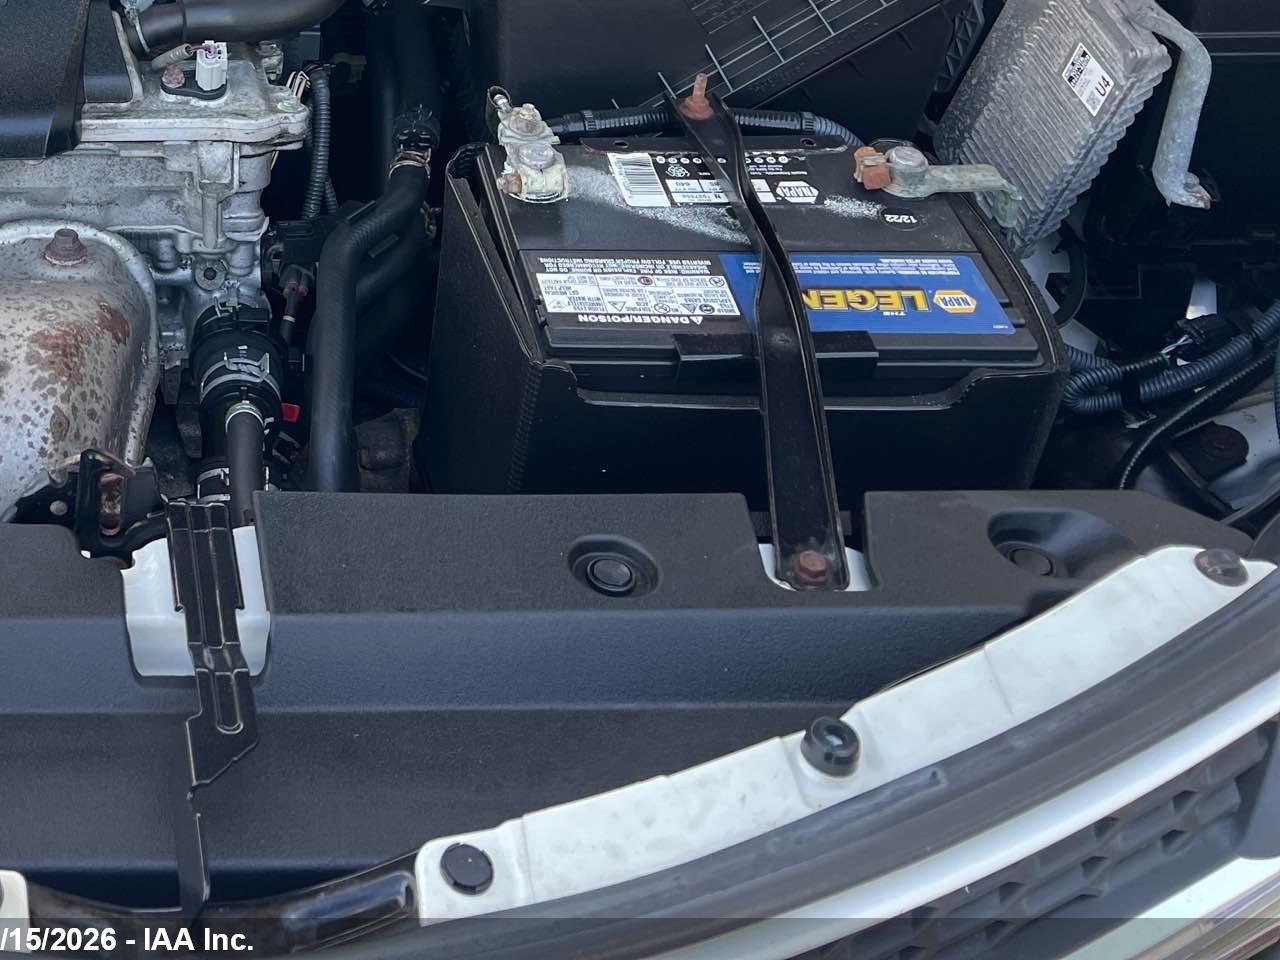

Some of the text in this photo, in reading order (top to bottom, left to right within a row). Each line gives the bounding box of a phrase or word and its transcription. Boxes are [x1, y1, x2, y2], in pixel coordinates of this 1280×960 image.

[1095, 75, 1111, 97] U4
[782, 186, 813, 197] NAPA
[884, 214, 918, 224] 12/22
[800, 289, 930, 310] LEGEN
[940, 296, 970, 306] NAPA
[578, 314, 690, 324] DANGER/POISON
